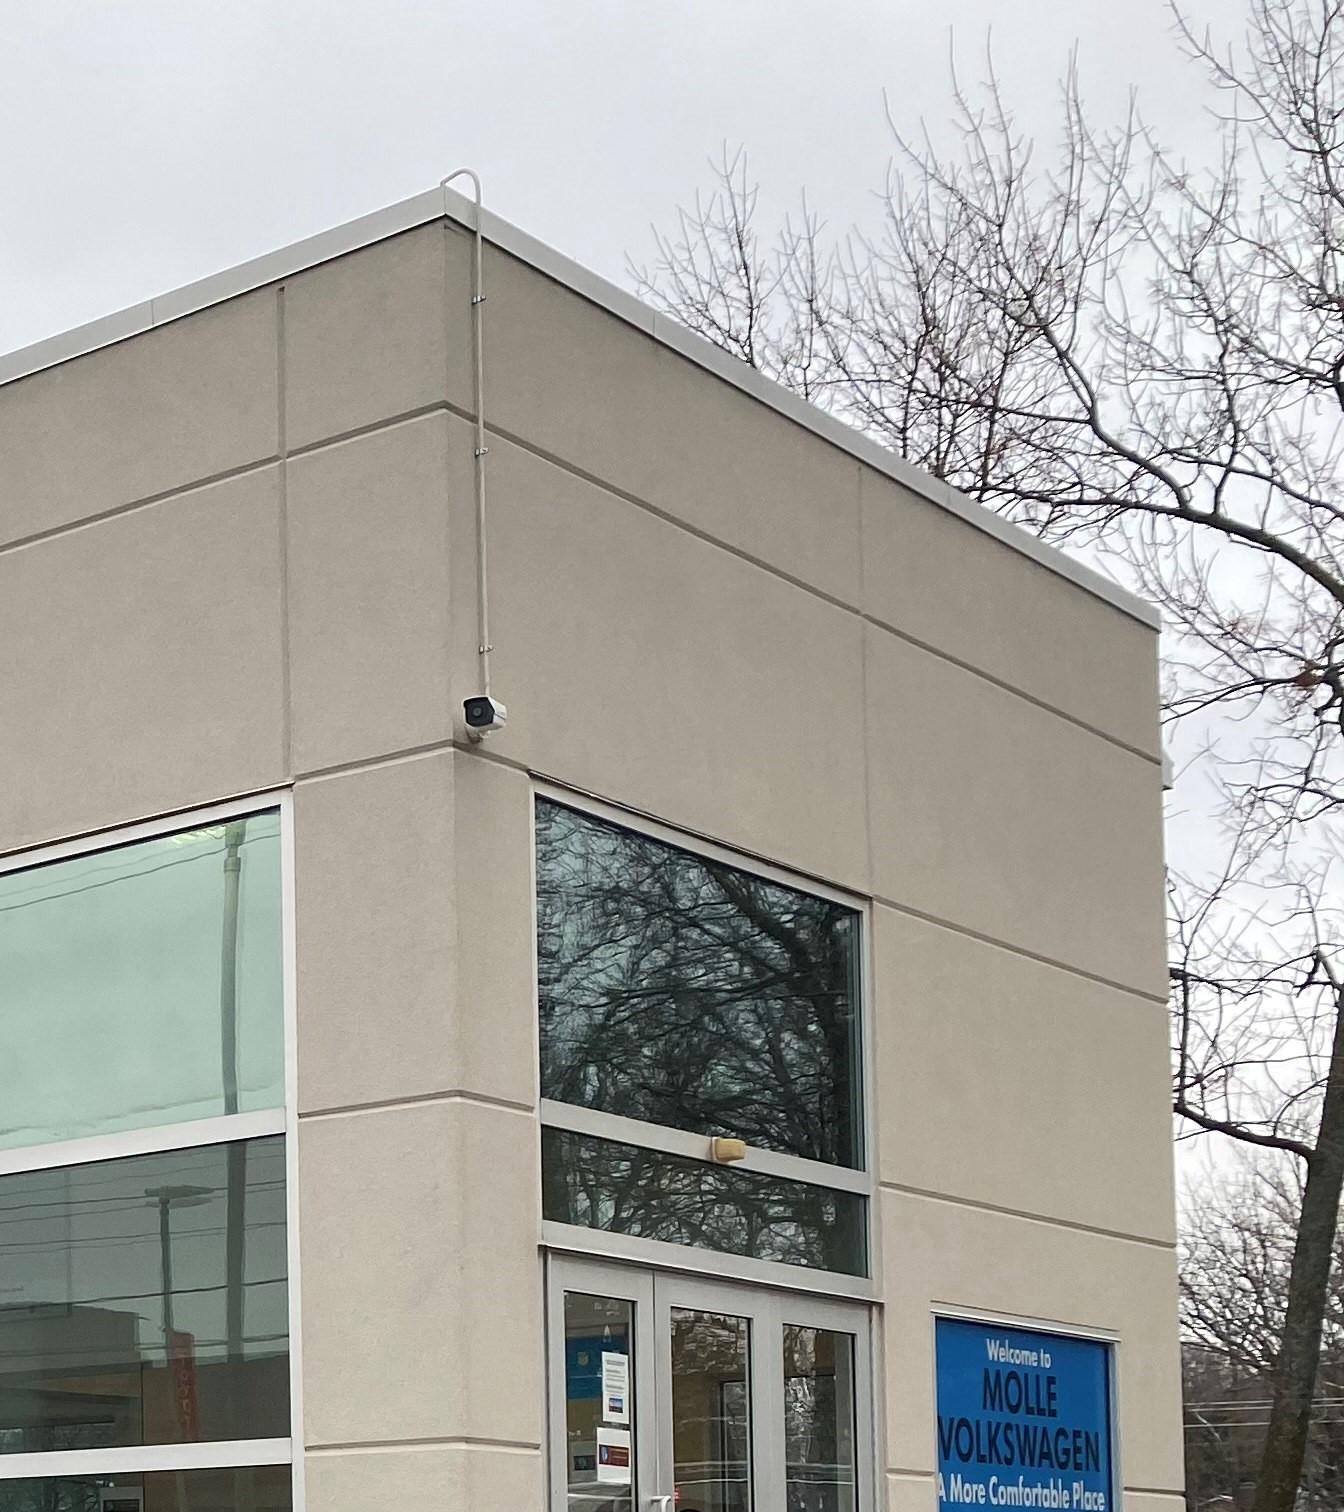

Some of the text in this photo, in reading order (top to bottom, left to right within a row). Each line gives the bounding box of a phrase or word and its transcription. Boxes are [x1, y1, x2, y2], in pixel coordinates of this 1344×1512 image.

[986, 1339, 1052, 1369] Welcome to
[983, 1367, 1058, 1418] MOLLE
[937, 1415, 1101, 1473] VOLKSWAGEN
[938, 1472, 1105, 1511] A More Comfortable Place
